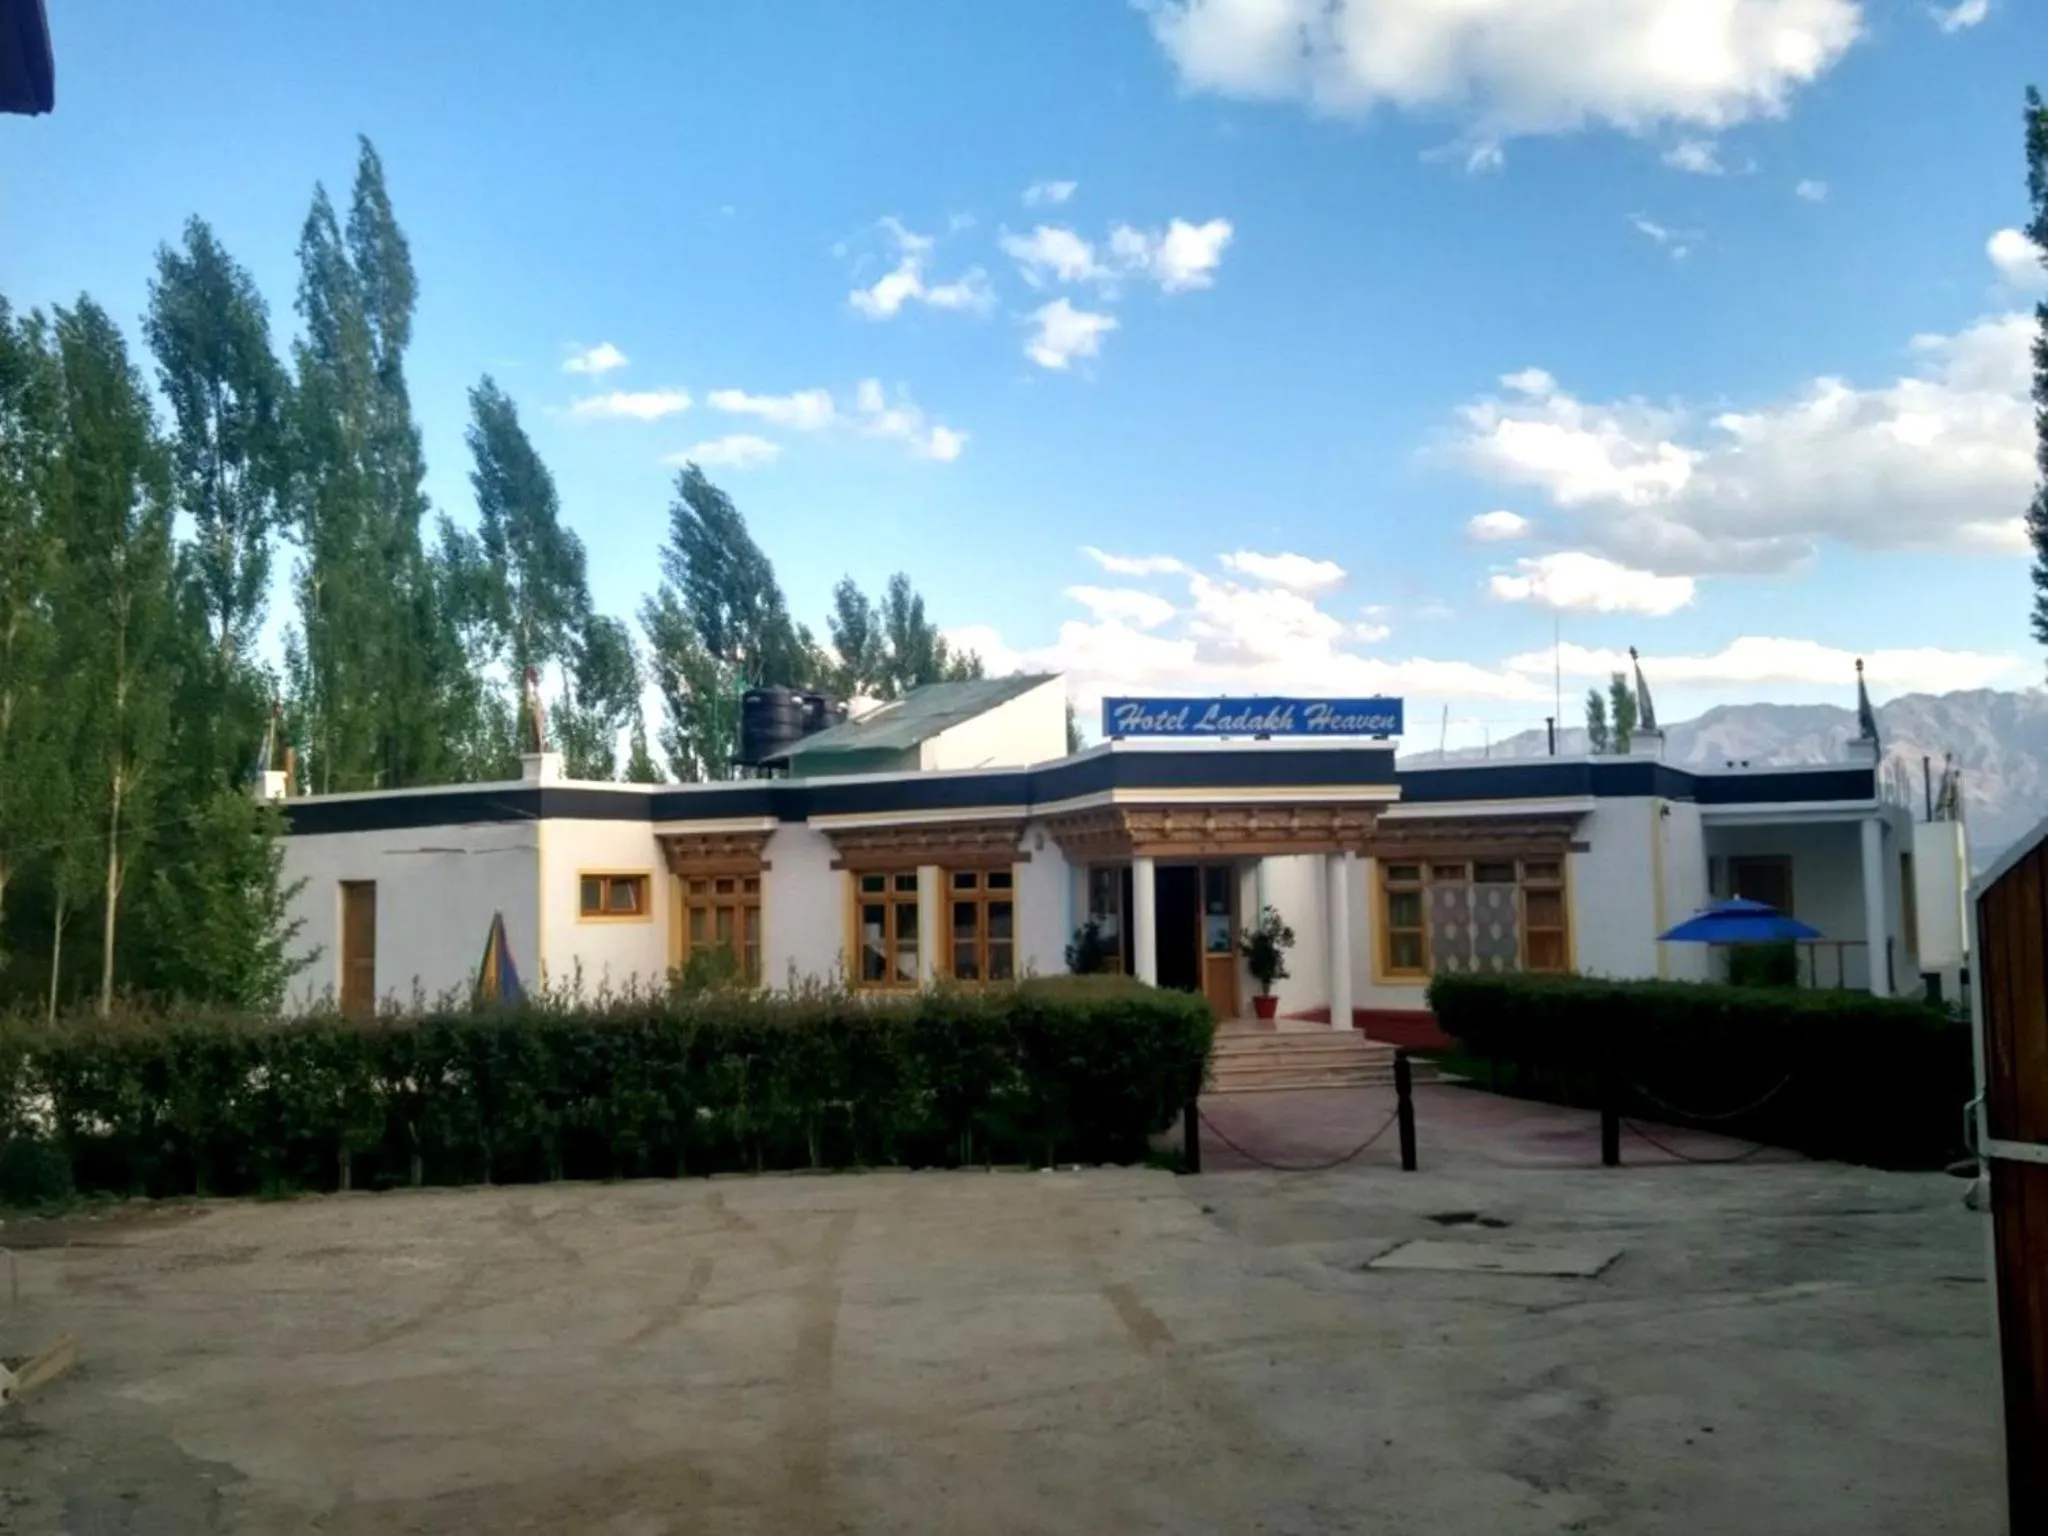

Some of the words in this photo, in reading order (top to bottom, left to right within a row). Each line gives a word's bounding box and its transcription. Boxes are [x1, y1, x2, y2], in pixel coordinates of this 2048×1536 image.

[1113, 703, 1189, 732] Hotel
[1194, 703, 1295, 731] Ladakh
[1303, 703, 1395, 730] Heaven
